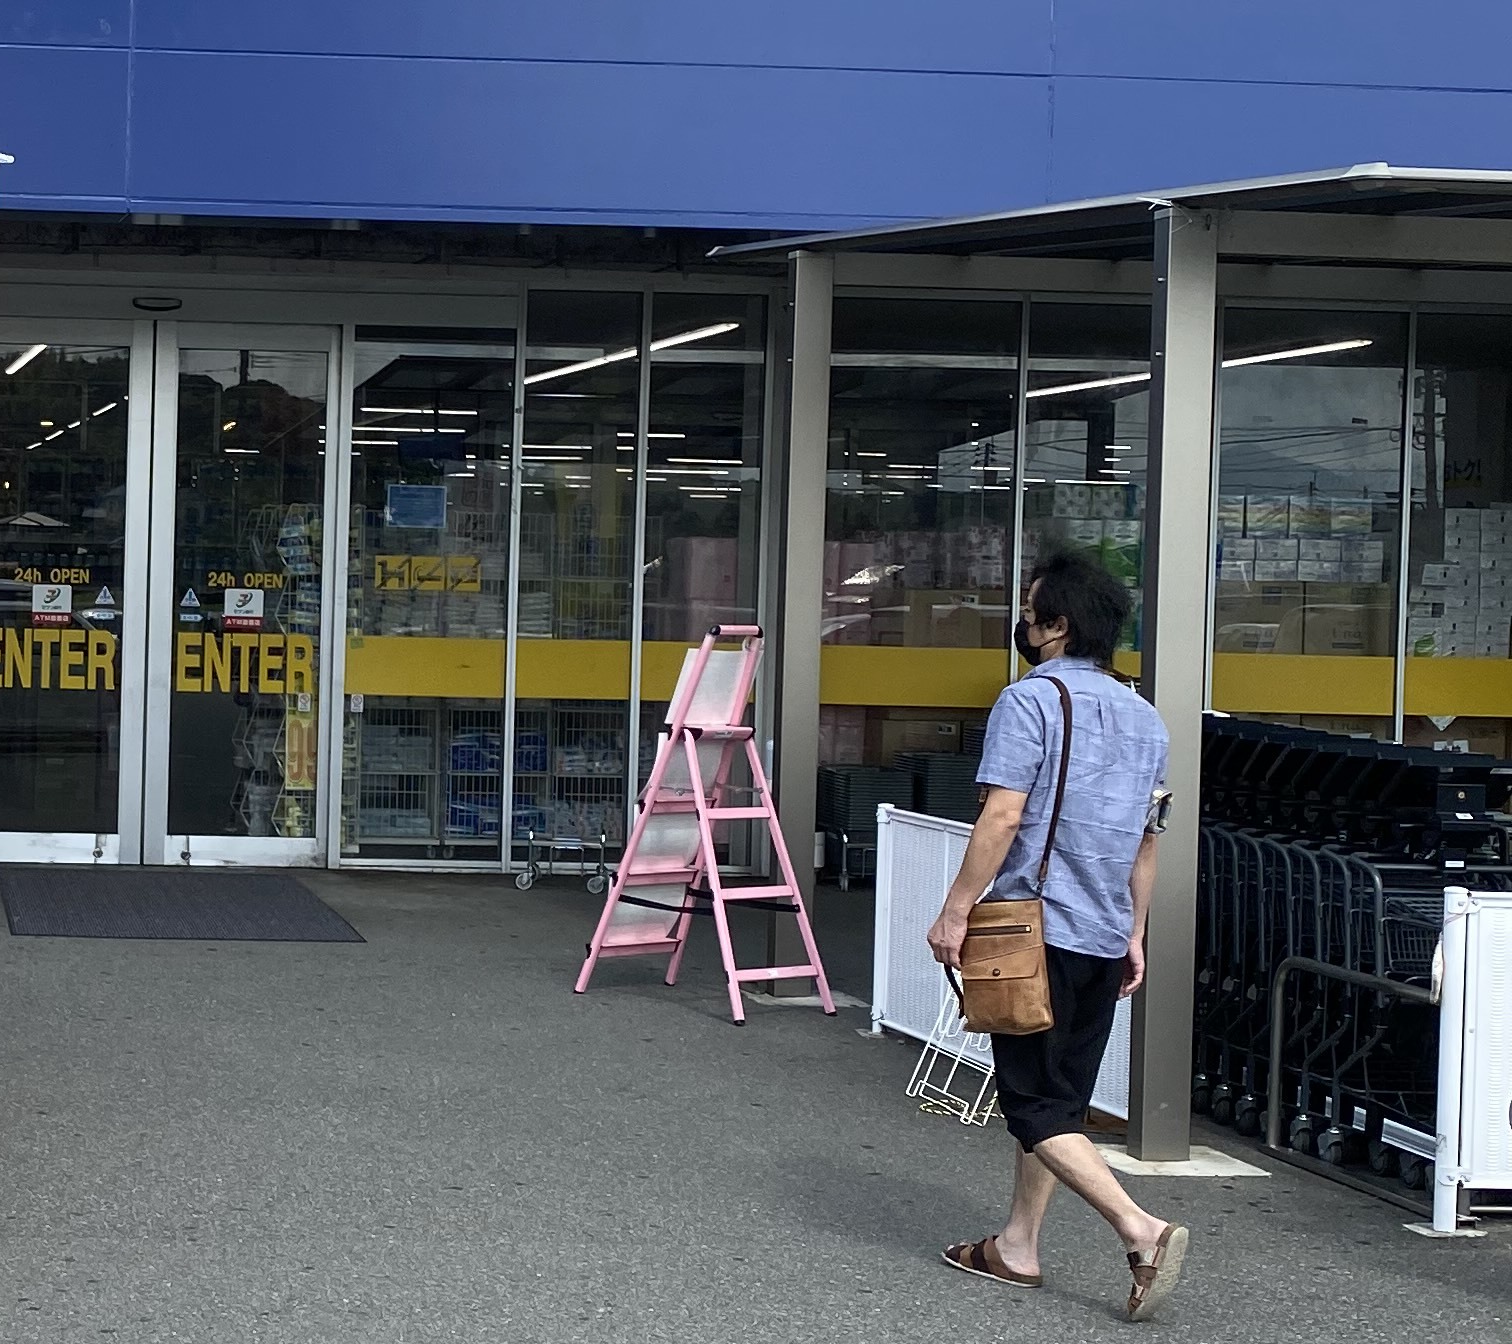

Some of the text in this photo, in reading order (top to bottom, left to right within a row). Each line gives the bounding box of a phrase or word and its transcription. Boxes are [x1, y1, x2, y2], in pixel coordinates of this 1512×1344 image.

[14, 568, 90, 584] 24h OPEN
[208, 572, 283, 588] 24h OPEN
[176, 632, 314, 694] ENTER
